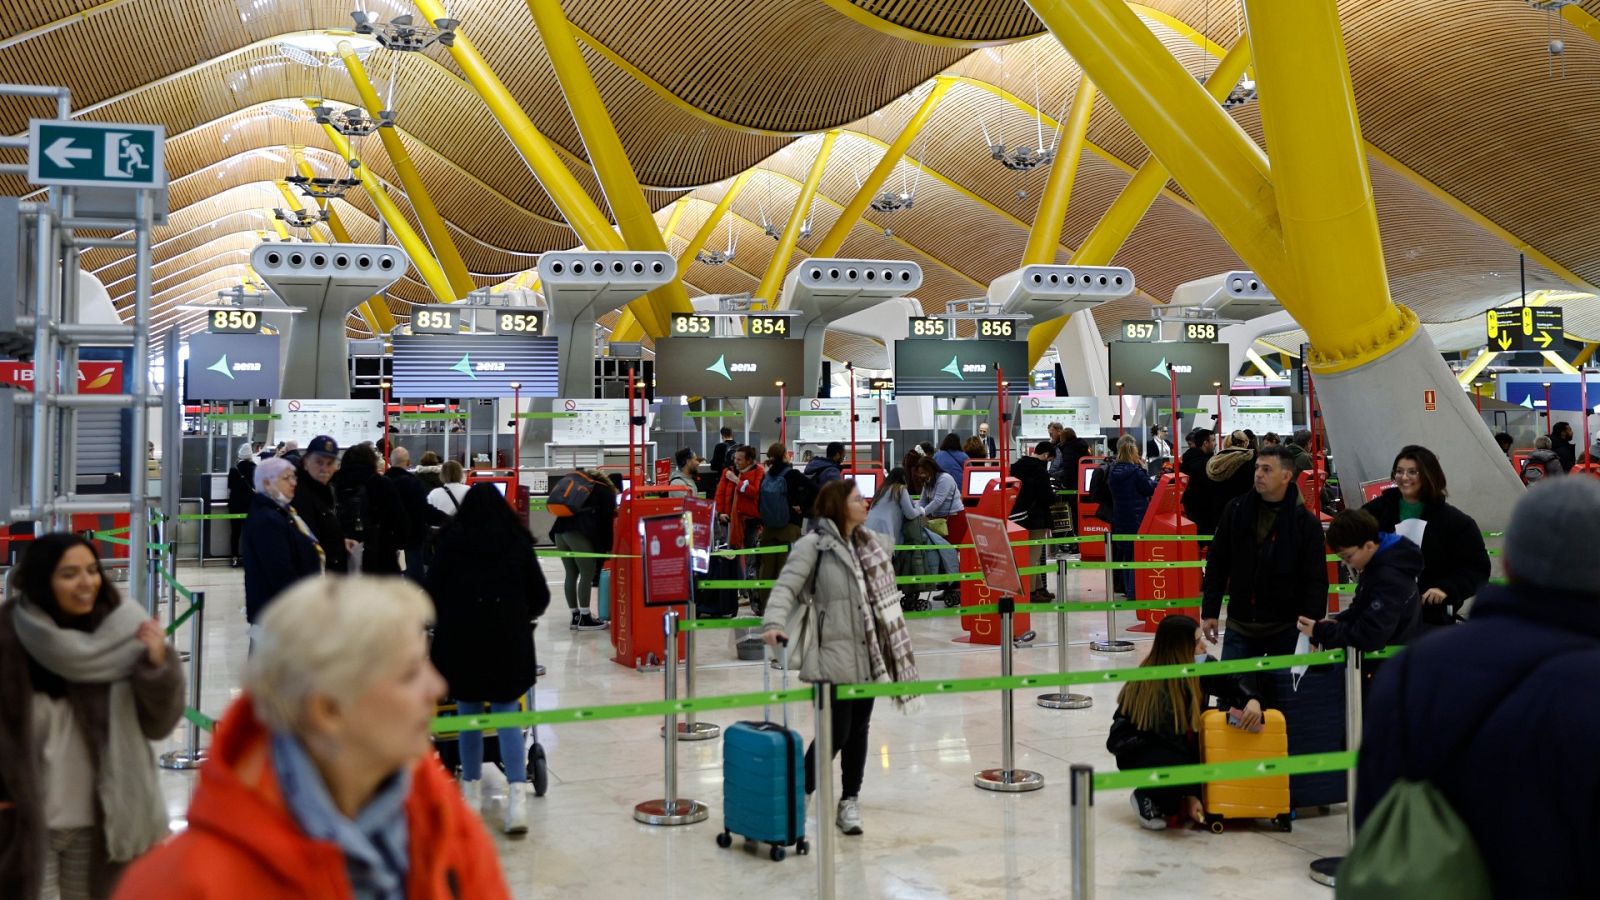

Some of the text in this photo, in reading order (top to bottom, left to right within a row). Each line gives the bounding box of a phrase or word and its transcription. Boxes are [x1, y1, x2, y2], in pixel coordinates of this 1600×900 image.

[214, 310, 257, 330] 850
[416, 311, 453, 329] 851
[500, 314, 538, 332] 852
[675, 316, 711, 333] 853
[751, 318, 786, 335] 854
[914, 320, 945, 336] 855
[981, 321, 1012, 336] 856
[1126, 323, 1155, 339] 857
[1187, 324, 1215, 339] 858
[232, 362, 261, 371] aena
[475, 361, 506, 372] aena
[730, 362, 757, 372] aena
[962, 363, 987, 372] aena
[13, 369, 86, 381] IBA
